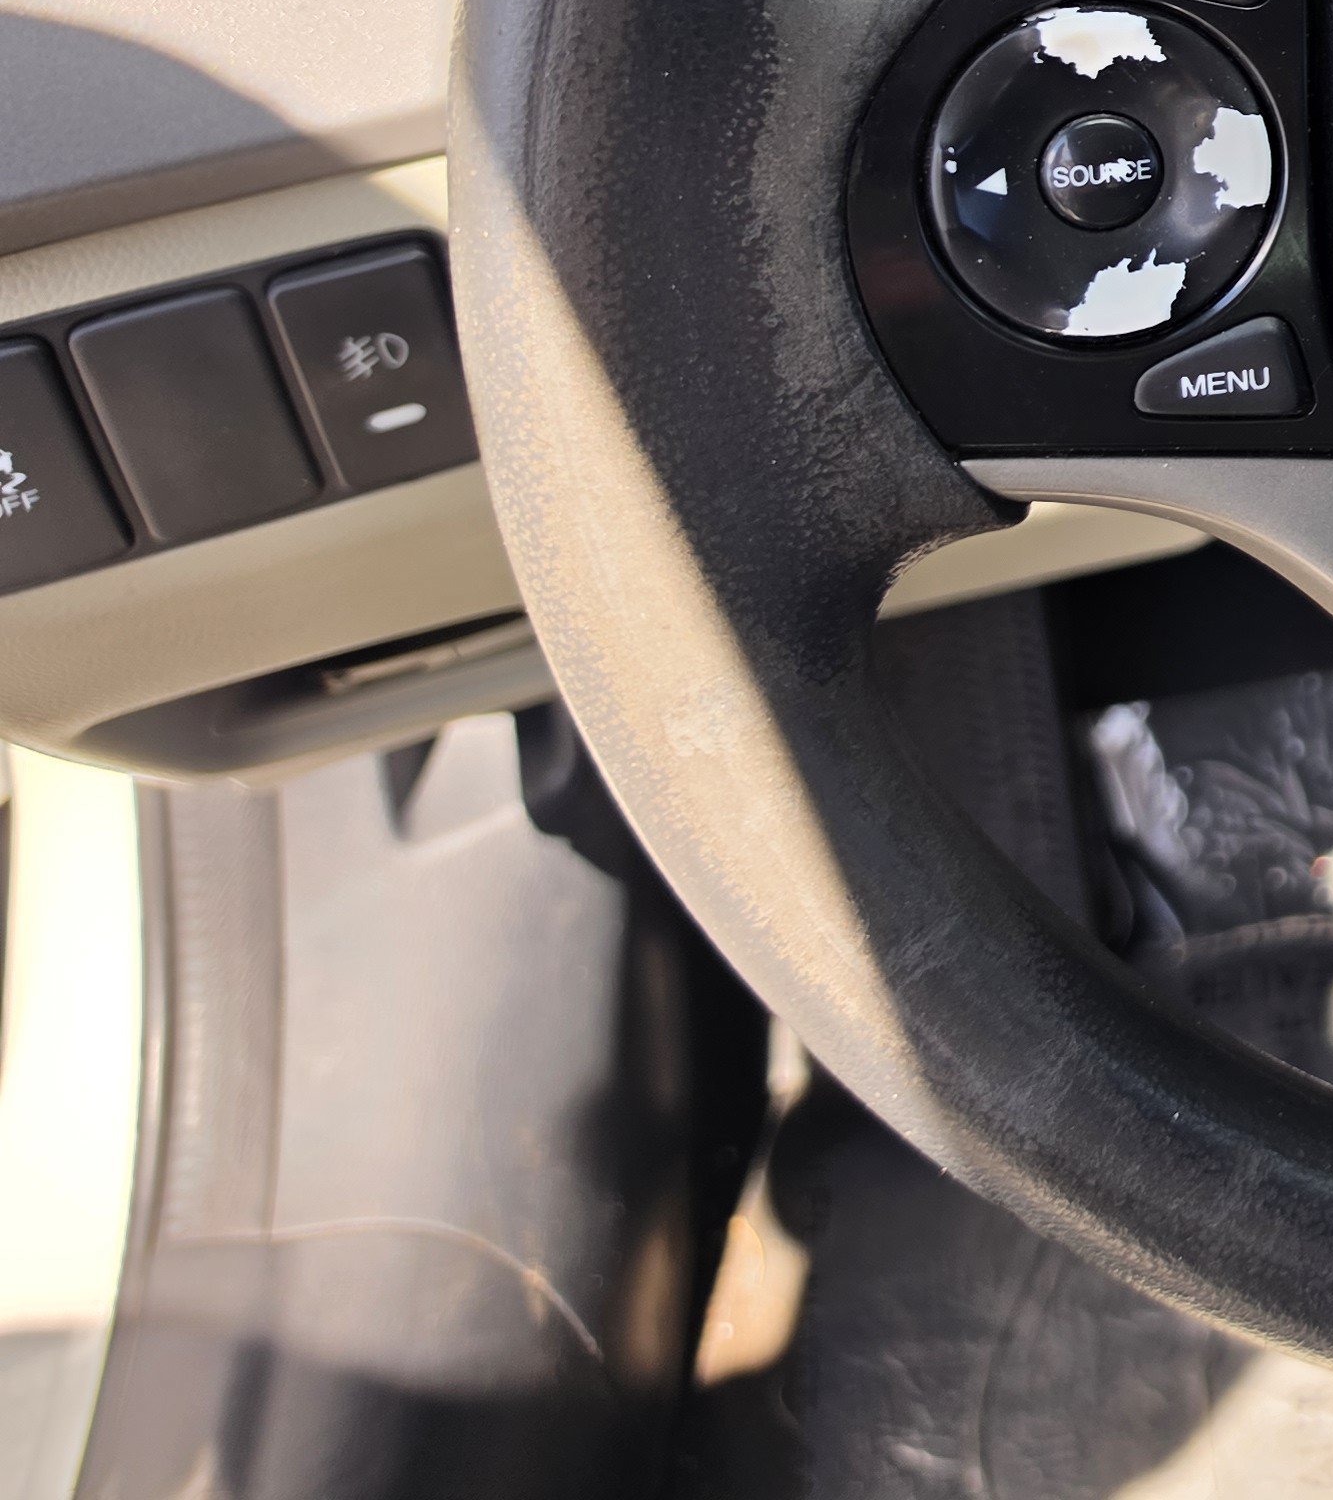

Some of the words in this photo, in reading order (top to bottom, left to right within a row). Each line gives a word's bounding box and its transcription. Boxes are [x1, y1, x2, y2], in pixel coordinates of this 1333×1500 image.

[1053, 157, 1153, 189] SOURCE
[1180, 366, 1271, 401] MENU
[0, 488, 40, 518] FF
